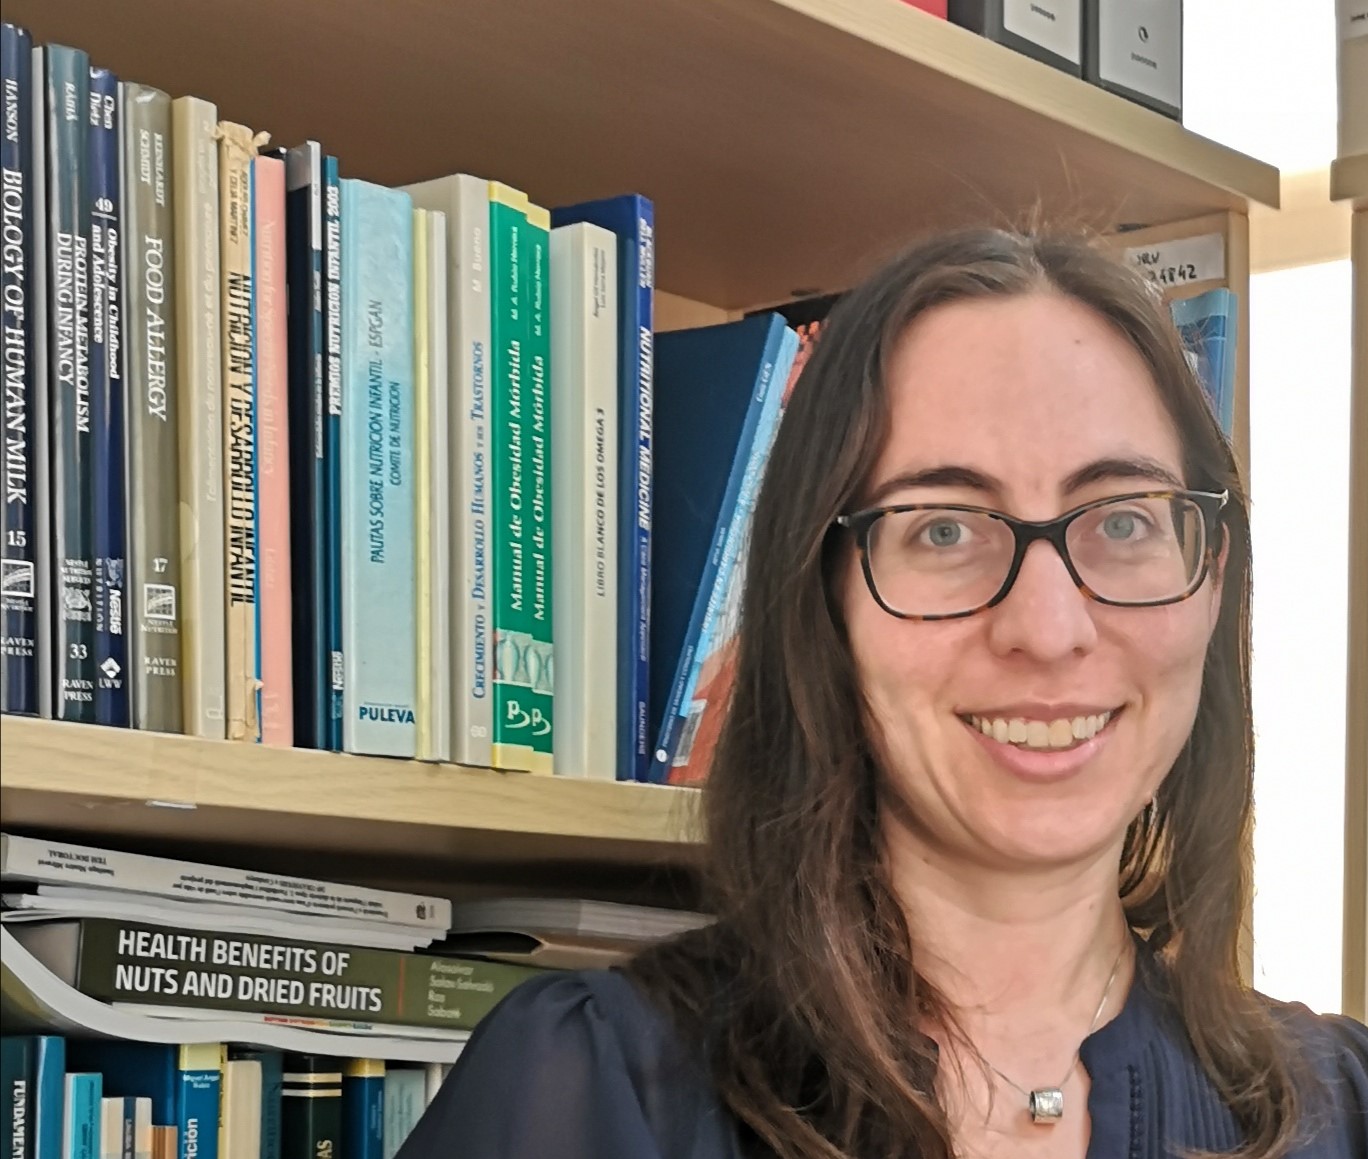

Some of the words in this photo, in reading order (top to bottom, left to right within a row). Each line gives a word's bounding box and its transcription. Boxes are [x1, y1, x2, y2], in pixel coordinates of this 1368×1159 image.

[5, 79, 19, 143] HANSON
[89, 92, 101, 126] Dietz
[103, 95, 115, 129] Chen
[140, 128, 152, 185] SCHMIDT
[3, 168, 22, 279] BIOLOGY
[92, 225, 105, 252] and
[327, 219, 340, 279] INFANTIL
[57, 232, 73, 302] DURING
[75, 236, 87, 311] PROTEIN
[107, 228, 119, 284] Obesity
[145, 235, 164, 303] FOOD
[5, 284, 24, 321] OF
[92, 255, 105, 343] Adolescence
[109, 286, 118, 300] in
[327, 283, 341, 353] NUTRICION
[58, 306, 74, 385] INFANCY
[109, 304, 120, 379] Childhood
[228, 271, 250, 373] NUTRICION
[368, 299, 383, 348] ESPGAN
[6, 326, 25, 433] HUMAN
[76, 317, 89, 432] METABOLISM
[147, 308, 166, 421] ALLERGY
[231, 382, 250, 394] Y
[328, 356, 342, 414] PREMIOS
[368, 360, 383, 409] INFANTIL
[507, 340, 522, 417] Mórbida
[638, 326, 651, 440] NUTRITIONAL
[388, 382, 401, 433] NUTRICION
[531, 356, 545, 432] Mórbida
[230, 398, 254, 520] DESARROLLO
[368, 411, 383, 476] NUTRICION
[389, 435, 400, 447] DE
[389, 449, 401, 485] COMITE
[508, 423, 522, 510] Obesidad
[596, 418, 605, 463] OMEGA
[6, 437, 26, 504] MILK
[369, 480, 383, 517] SOBRE
[532, 436, 545, 521] Obesidad
[597, 466, 605, 488] LOS
[597, 490, 605, 507] DE
[639, 444, 651, 530] MEDICINE
[7, 530, 27, 547] 15
[369, 520, 384, 563] PAUTAS
[509, 514, 522, 537] de
[532, 526, 545, 549] de
[597, 510, 605, 558] BLANCO
[152, 558, 168, 572] 17
[230, 526, 255, 606] INFANTIL
[509, 541, 523, 611] Manual
[532, 554, 545, 620] Manual
[597, 561, 605, 597] LIBRO
[69, 644, 88, 660] 33
[359, 706, 415, 724] PULEVA
[118, 929, 207, 963] HEALTH
[211, 938, 317, 974] BENEFITS
[322, 949, 350, 977] OF
[115, 964, 178, 994] NUTS
[182, 971, 233, 1000] AND
[238, 976, 304, 1005] DRIED
[308, 983, 383, 1012] FRUITS
